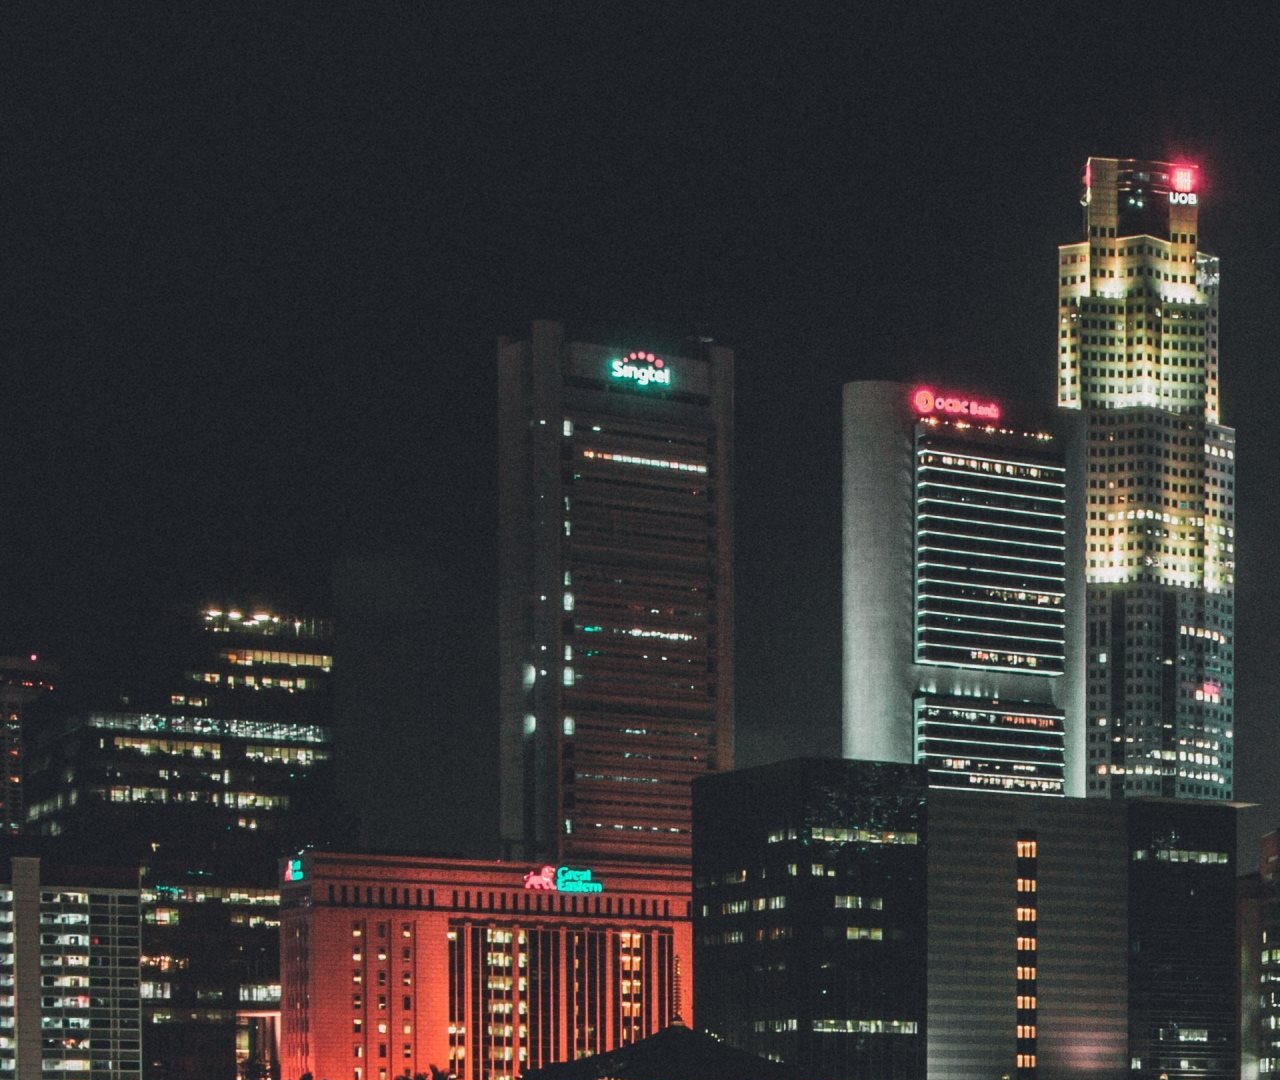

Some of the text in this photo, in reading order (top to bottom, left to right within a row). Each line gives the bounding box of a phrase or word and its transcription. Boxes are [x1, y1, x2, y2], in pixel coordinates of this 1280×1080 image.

[1169, 192, 1197, 205] UOB
[612, 360, 671, 385] Singtel
[935, 398, 969, 413] OCBC
[557, 867, 592, 881] Great
[557, 880, 603, 893] Eastern
